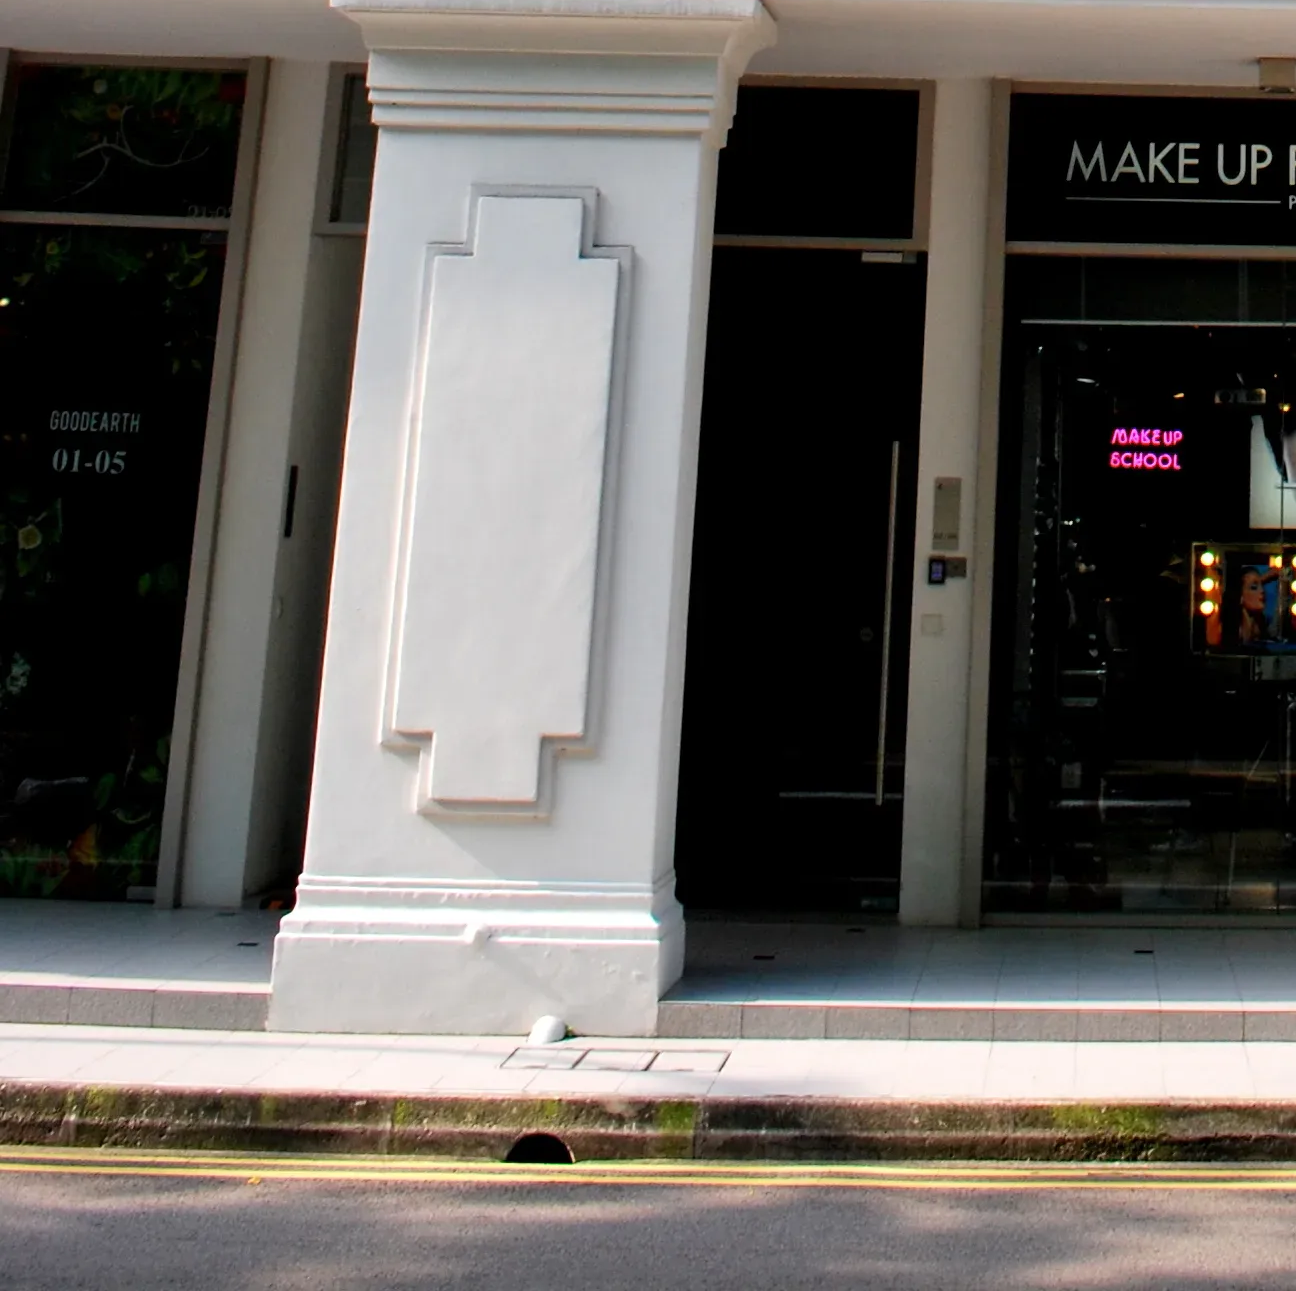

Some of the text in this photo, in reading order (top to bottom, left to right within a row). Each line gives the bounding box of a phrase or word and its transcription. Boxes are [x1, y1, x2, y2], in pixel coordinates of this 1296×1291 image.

[1066, 140, 1200, 184] MAKE
[1217, 144, 1273, 186] UP
[50, 410, 141, 433] GOODEARTH
[1111, 427, 1184, 447] MAKE UP
[52, 448, 127, 474] 01-05
[1110, 451, 1182, 471] SCHOOL
